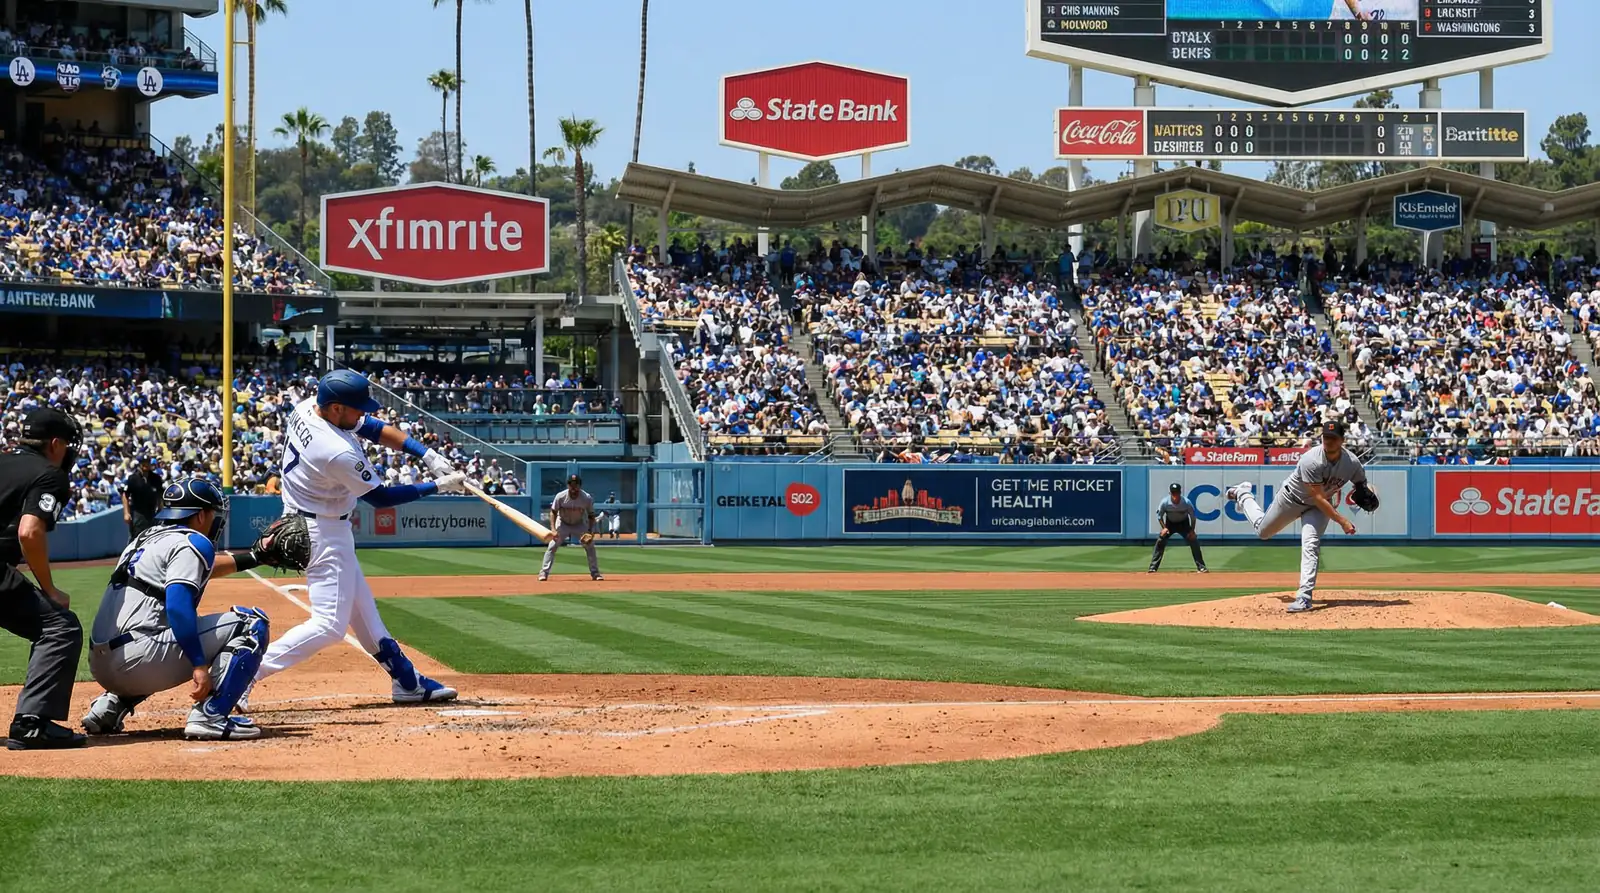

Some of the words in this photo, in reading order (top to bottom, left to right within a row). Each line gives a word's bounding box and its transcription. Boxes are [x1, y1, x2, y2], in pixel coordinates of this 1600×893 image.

[1529, 9, 1535, 19] 3
[1362, 22, 1368, 30] 9
[1529, 23, 1535, 33] 3
[1344, 34, 1352, 44] 0
[1361, 34, 1368, 44] 0
[1381, 34, 1388, 44] 0
[1402, 34, 1409, 44] 0
[1344, 49, 1352, 60] 0
[1361, 49, 1368, 60] 0
[1381, 49, 1388, 60] 2
[1401, 49, 1409, 60] 2
[766, 98, 834, 121] State
[837, 99, 898, 122] Bank
[1246, 113, 1252, 122] 3
[1292, 113, 1298, 122] 5
[1308, 113, 1314, 122] 6
[1339, 113, 1345, 122] 8
[1355, 114, 1361, 122] 9
[1402, 114, 1408, 123] 2
[1062, 119, 1140, 145] Coca-Cola
[1215, 125, 1223, 137] 0
[1230, 125, 1238, 137] 0
[1245, 125, 1254, 137] 0
[1377, 125, 1385, 138] 0
[1215, 141, 1223, 153] 0
[1230, 141, 1238, 153] 0
[1245, 141, 1254, 153] 0
[1377, 142, 1385, 154] 0
[991, 479, 1020, 491] GET
[1053, 479, 1114, 492] RTICKET
[791, 493, 814, 504] 502
[991, 496, 1053, 508] HEALTH
[1495, 487, 1570, 516] State
